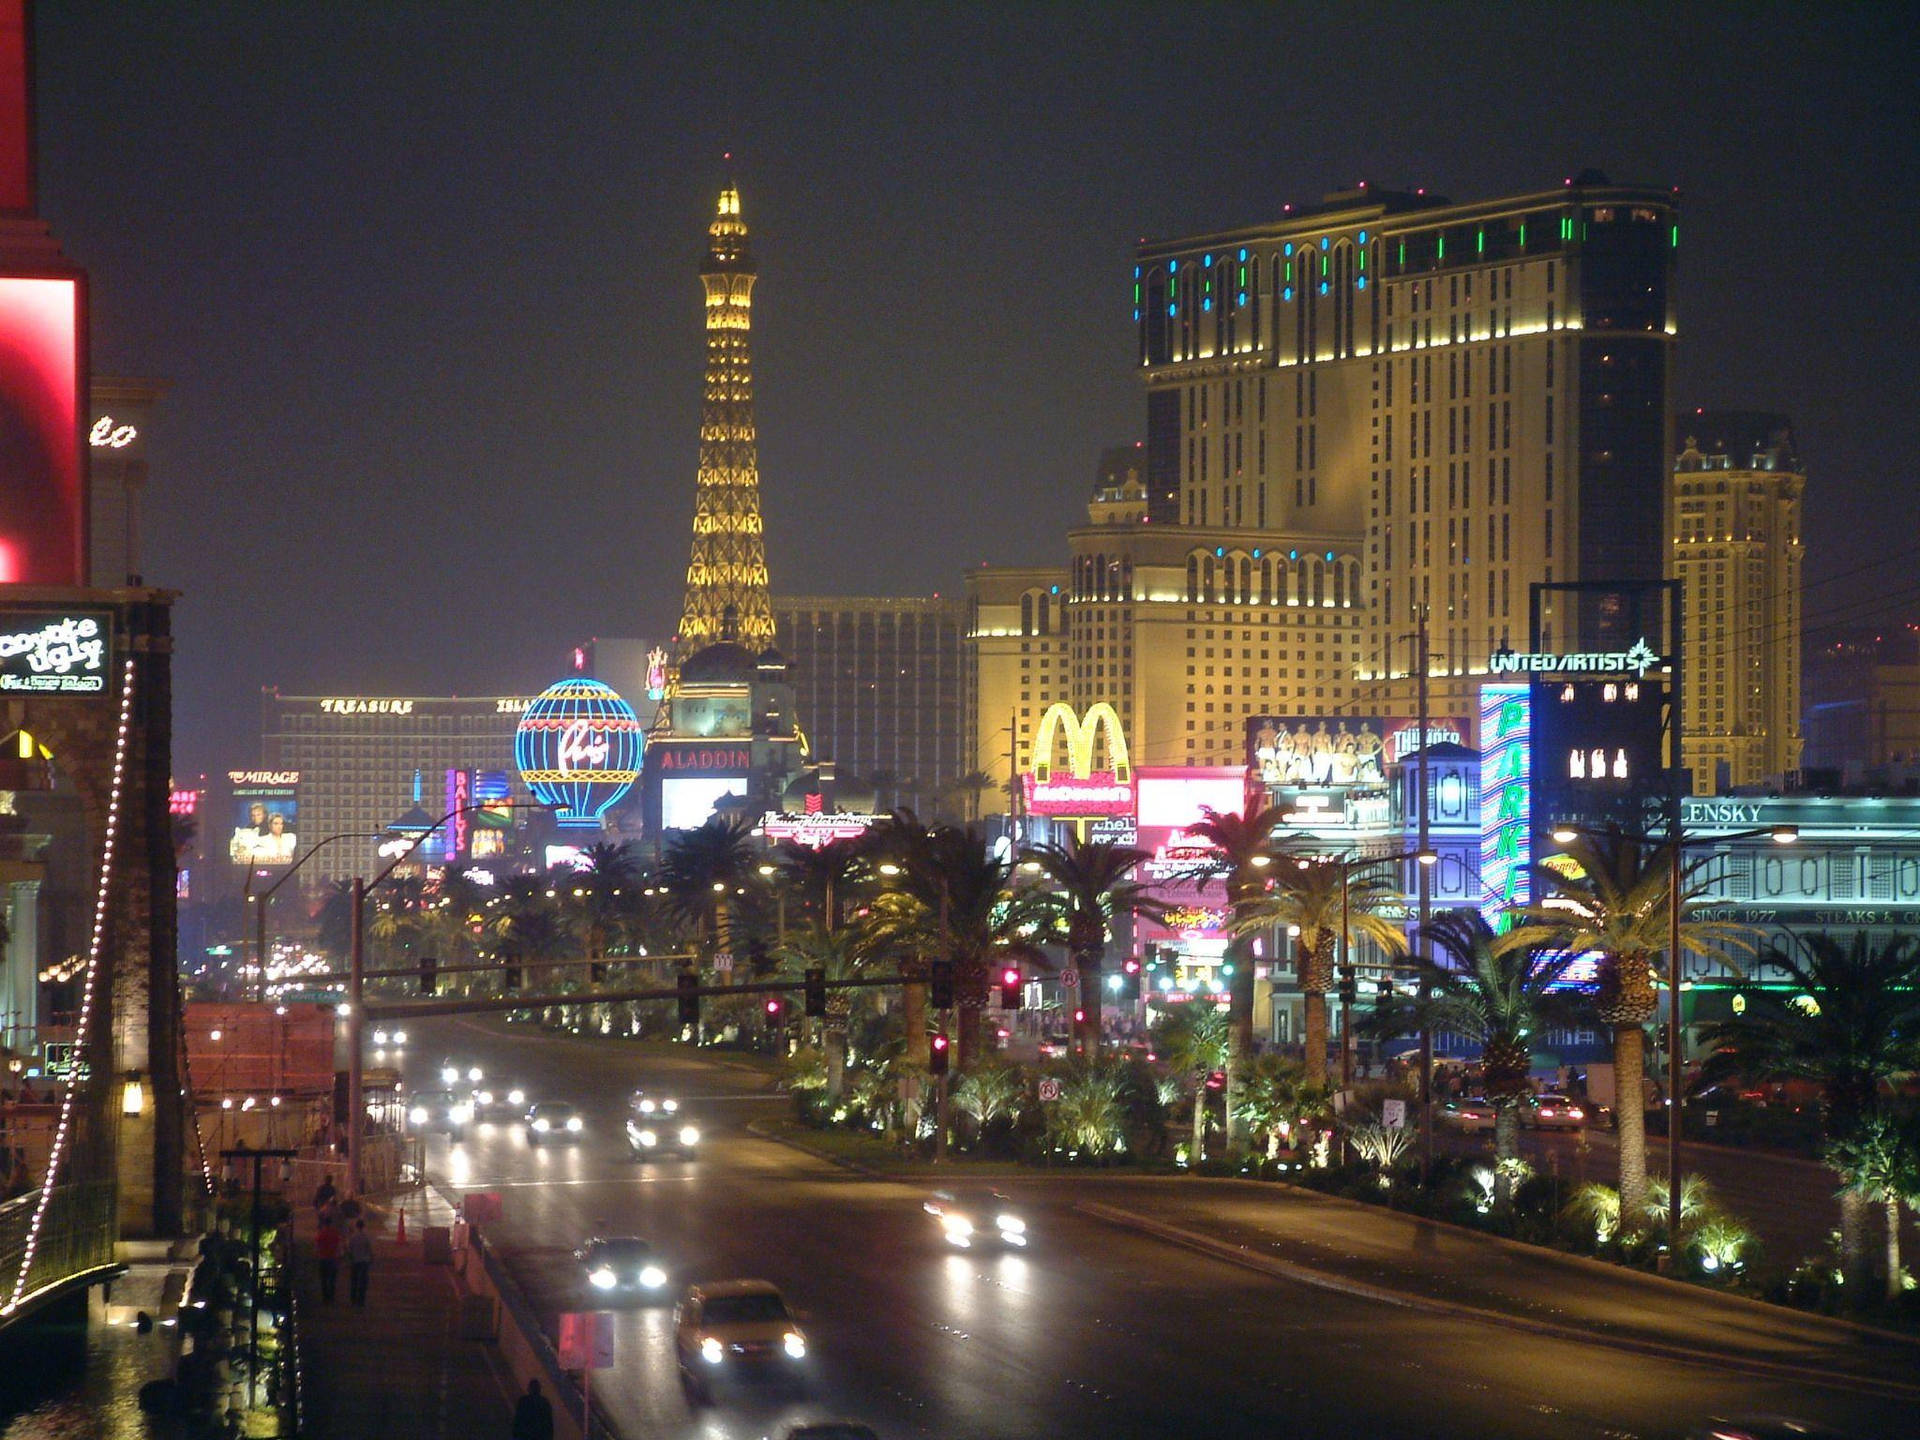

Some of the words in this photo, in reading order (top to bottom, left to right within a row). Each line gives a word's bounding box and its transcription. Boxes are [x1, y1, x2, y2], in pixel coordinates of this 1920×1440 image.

[0, 617, 98, 657] coyote
[26, 639, 104, 673] ugly
[1490, 653, 1557, 672] UNITED
[1557, 653, 1640, 672] ARTISTS
[320, 699, 413, 715] TREASURE
[661, 751, 750, 769] ALADDIN
[233, 771, 299, 784] MIRAGE
[1691, 910, 1737, 923] SINCE
[1745, 909, 1777, 923] 1977
[1815, 910, 1876, 923] STEAKS
